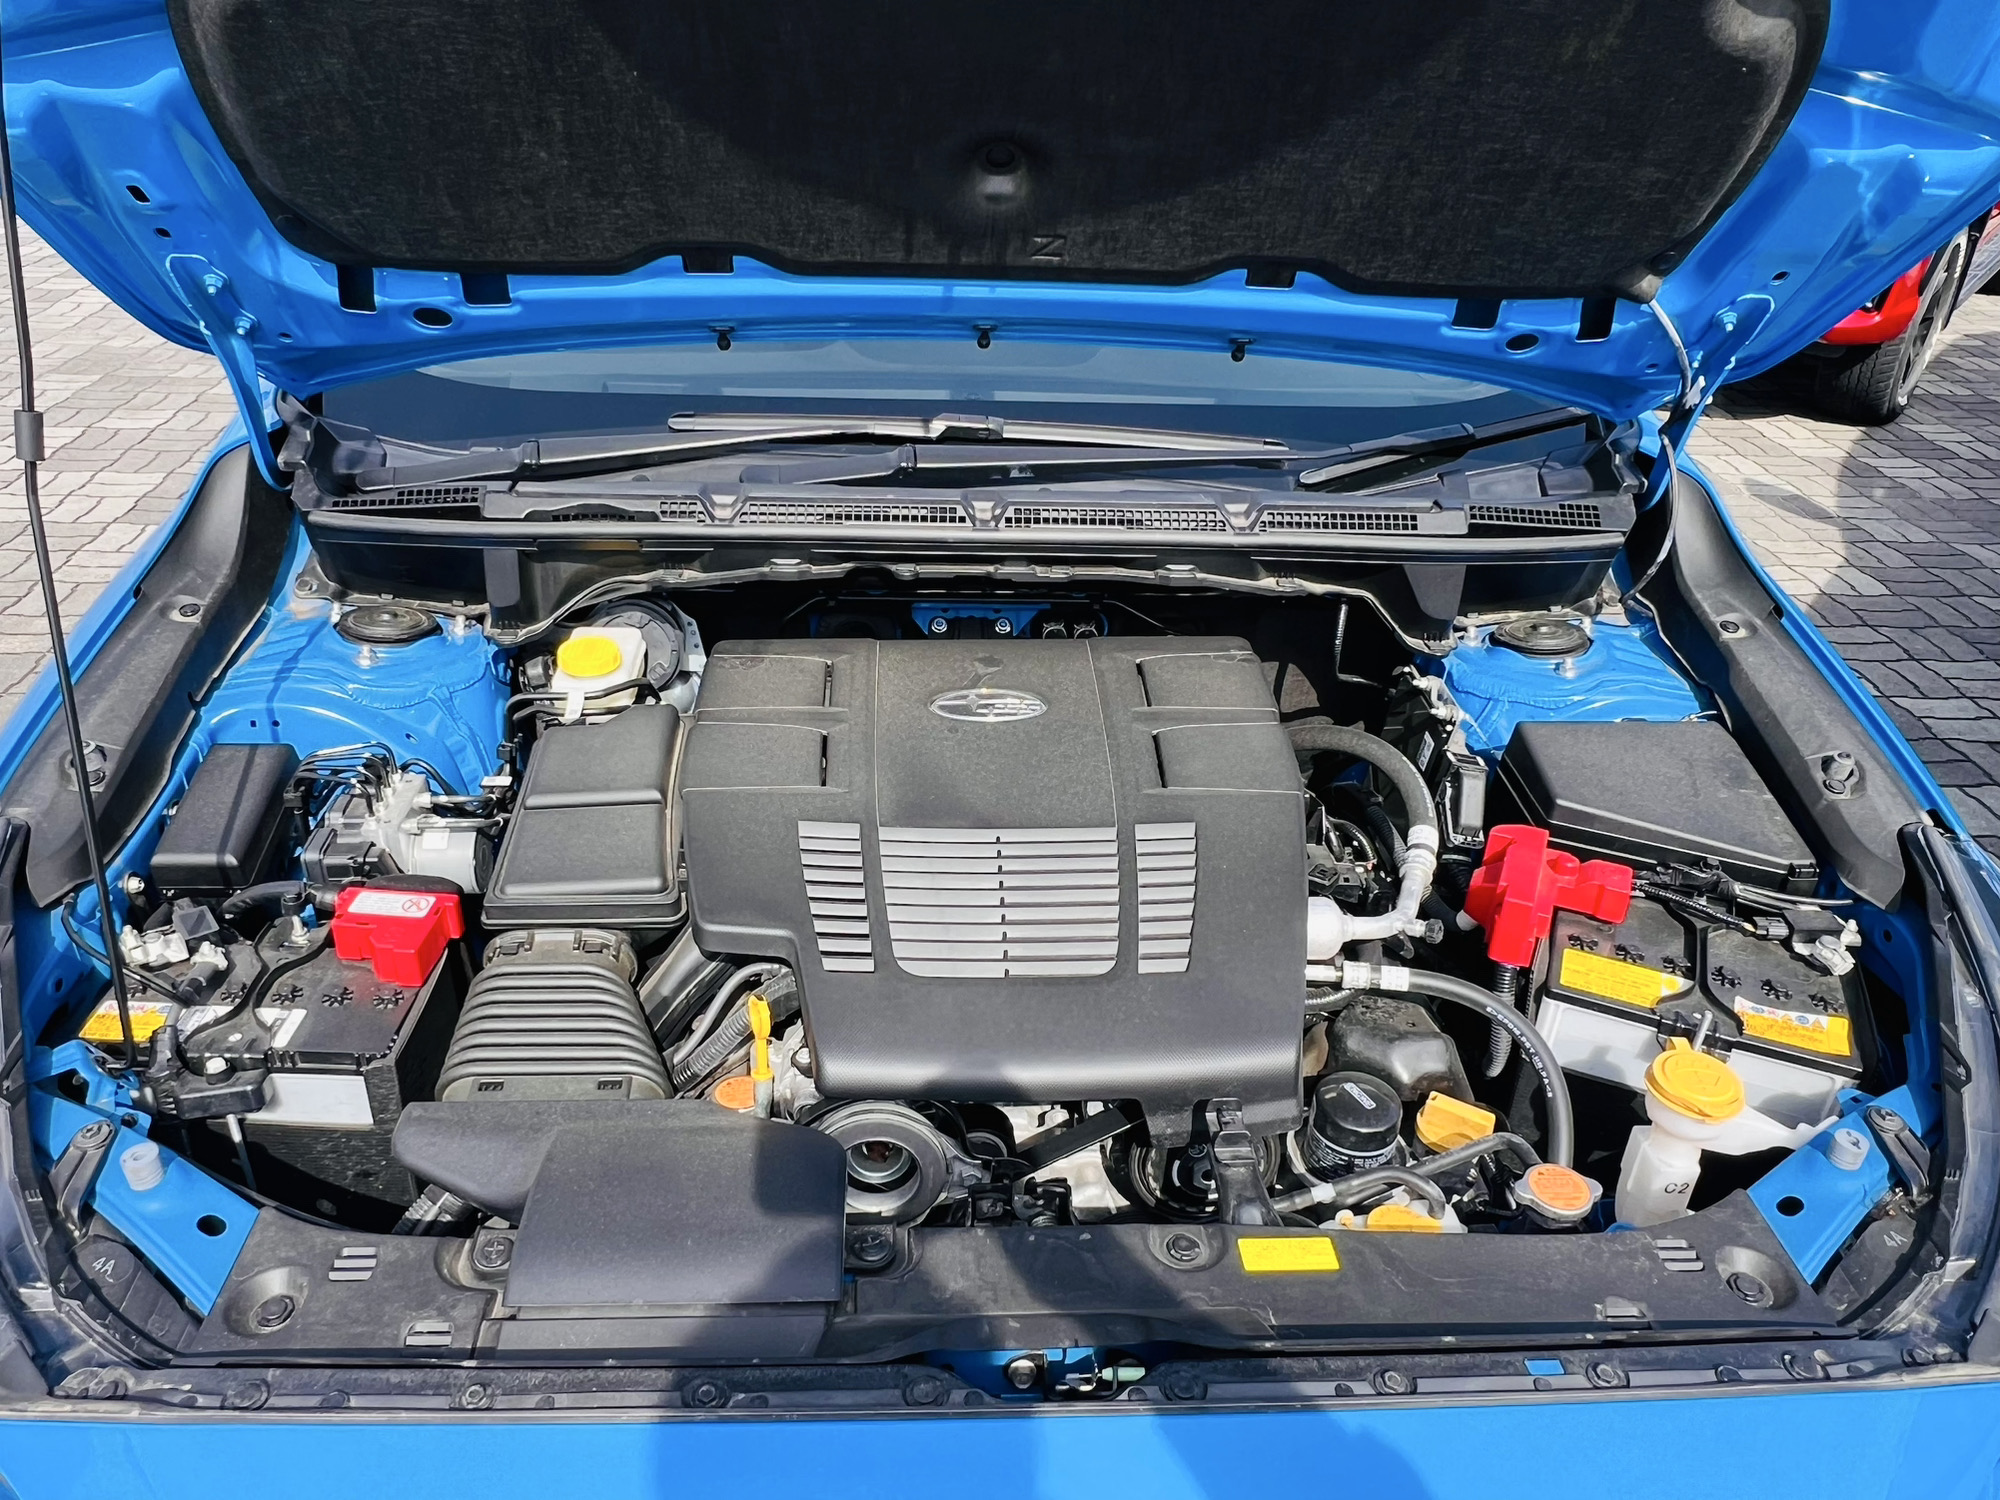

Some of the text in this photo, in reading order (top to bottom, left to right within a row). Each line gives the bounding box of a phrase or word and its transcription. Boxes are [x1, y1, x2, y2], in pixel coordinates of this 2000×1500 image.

[1664, 1182, 1690, 1194] C2
[1883, 1230, 1908, 1247] 4A
[92, 1256, 115, 1275] 4A
